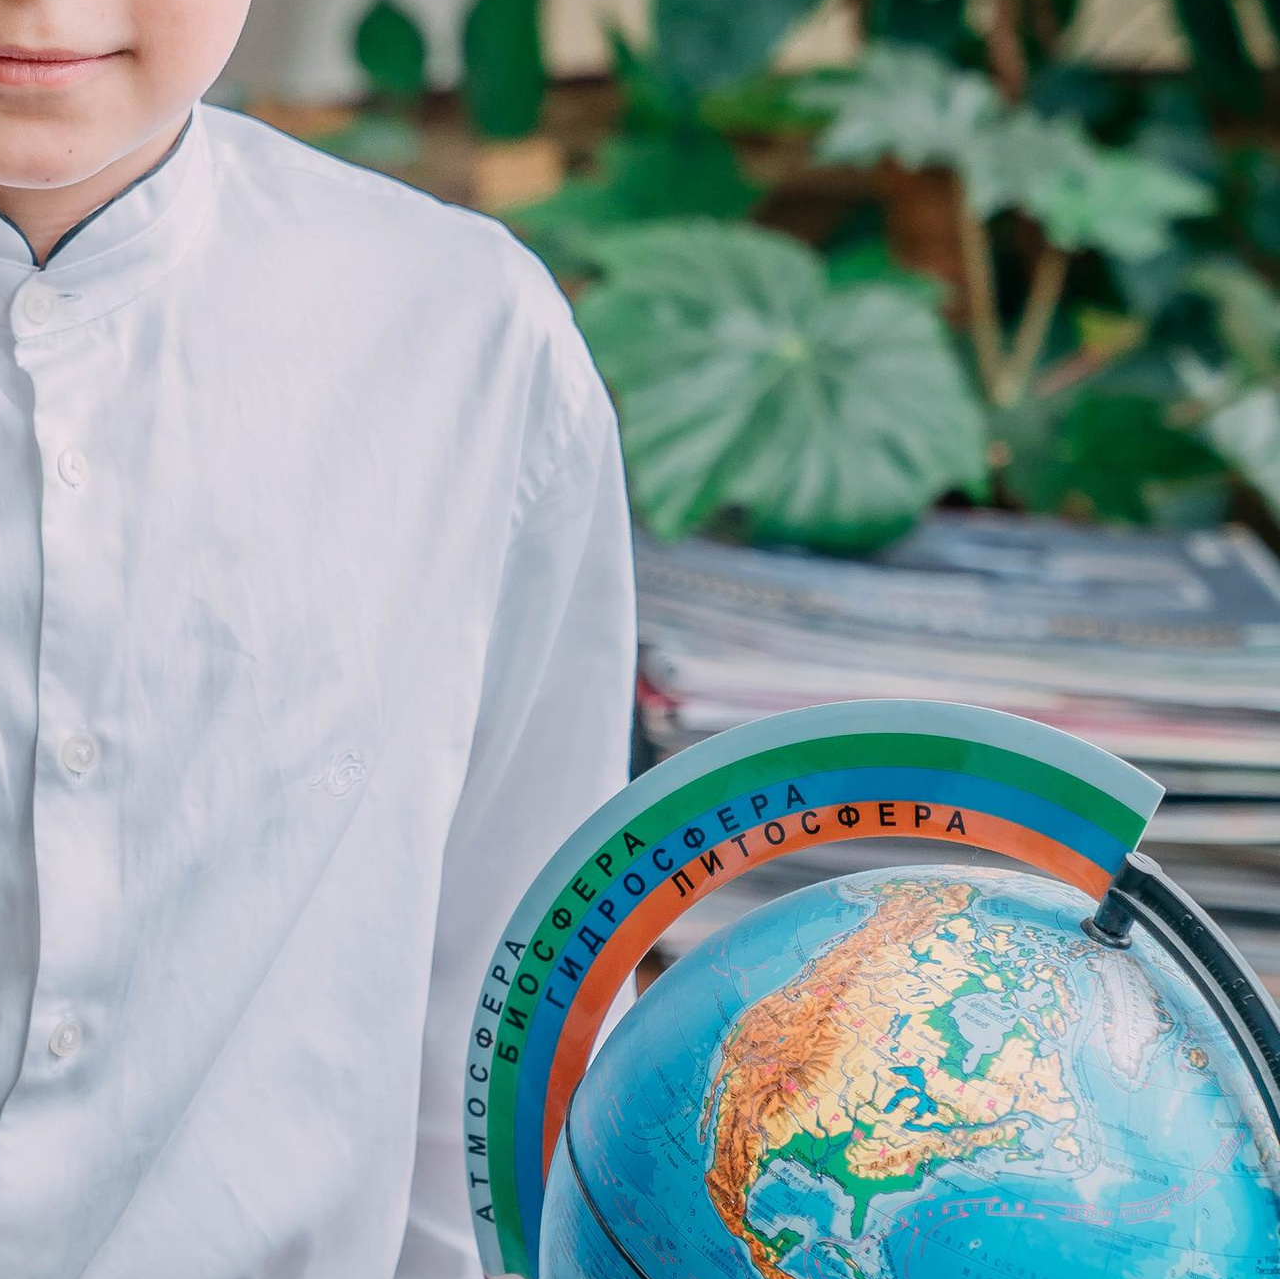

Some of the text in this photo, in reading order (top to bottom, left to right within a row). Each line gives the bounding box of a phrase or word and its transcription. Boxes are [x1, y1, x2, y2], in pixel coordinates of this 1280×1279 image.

[497, 830, 647, 1065] БИОСФЕРА
[545, 783, 807, 1011] ГИДРОСФЕРА
[670, 802, 967, 898] ЛИТОСФЕРА
[466, 939, 527, 1224] АТМОСФЕРА
